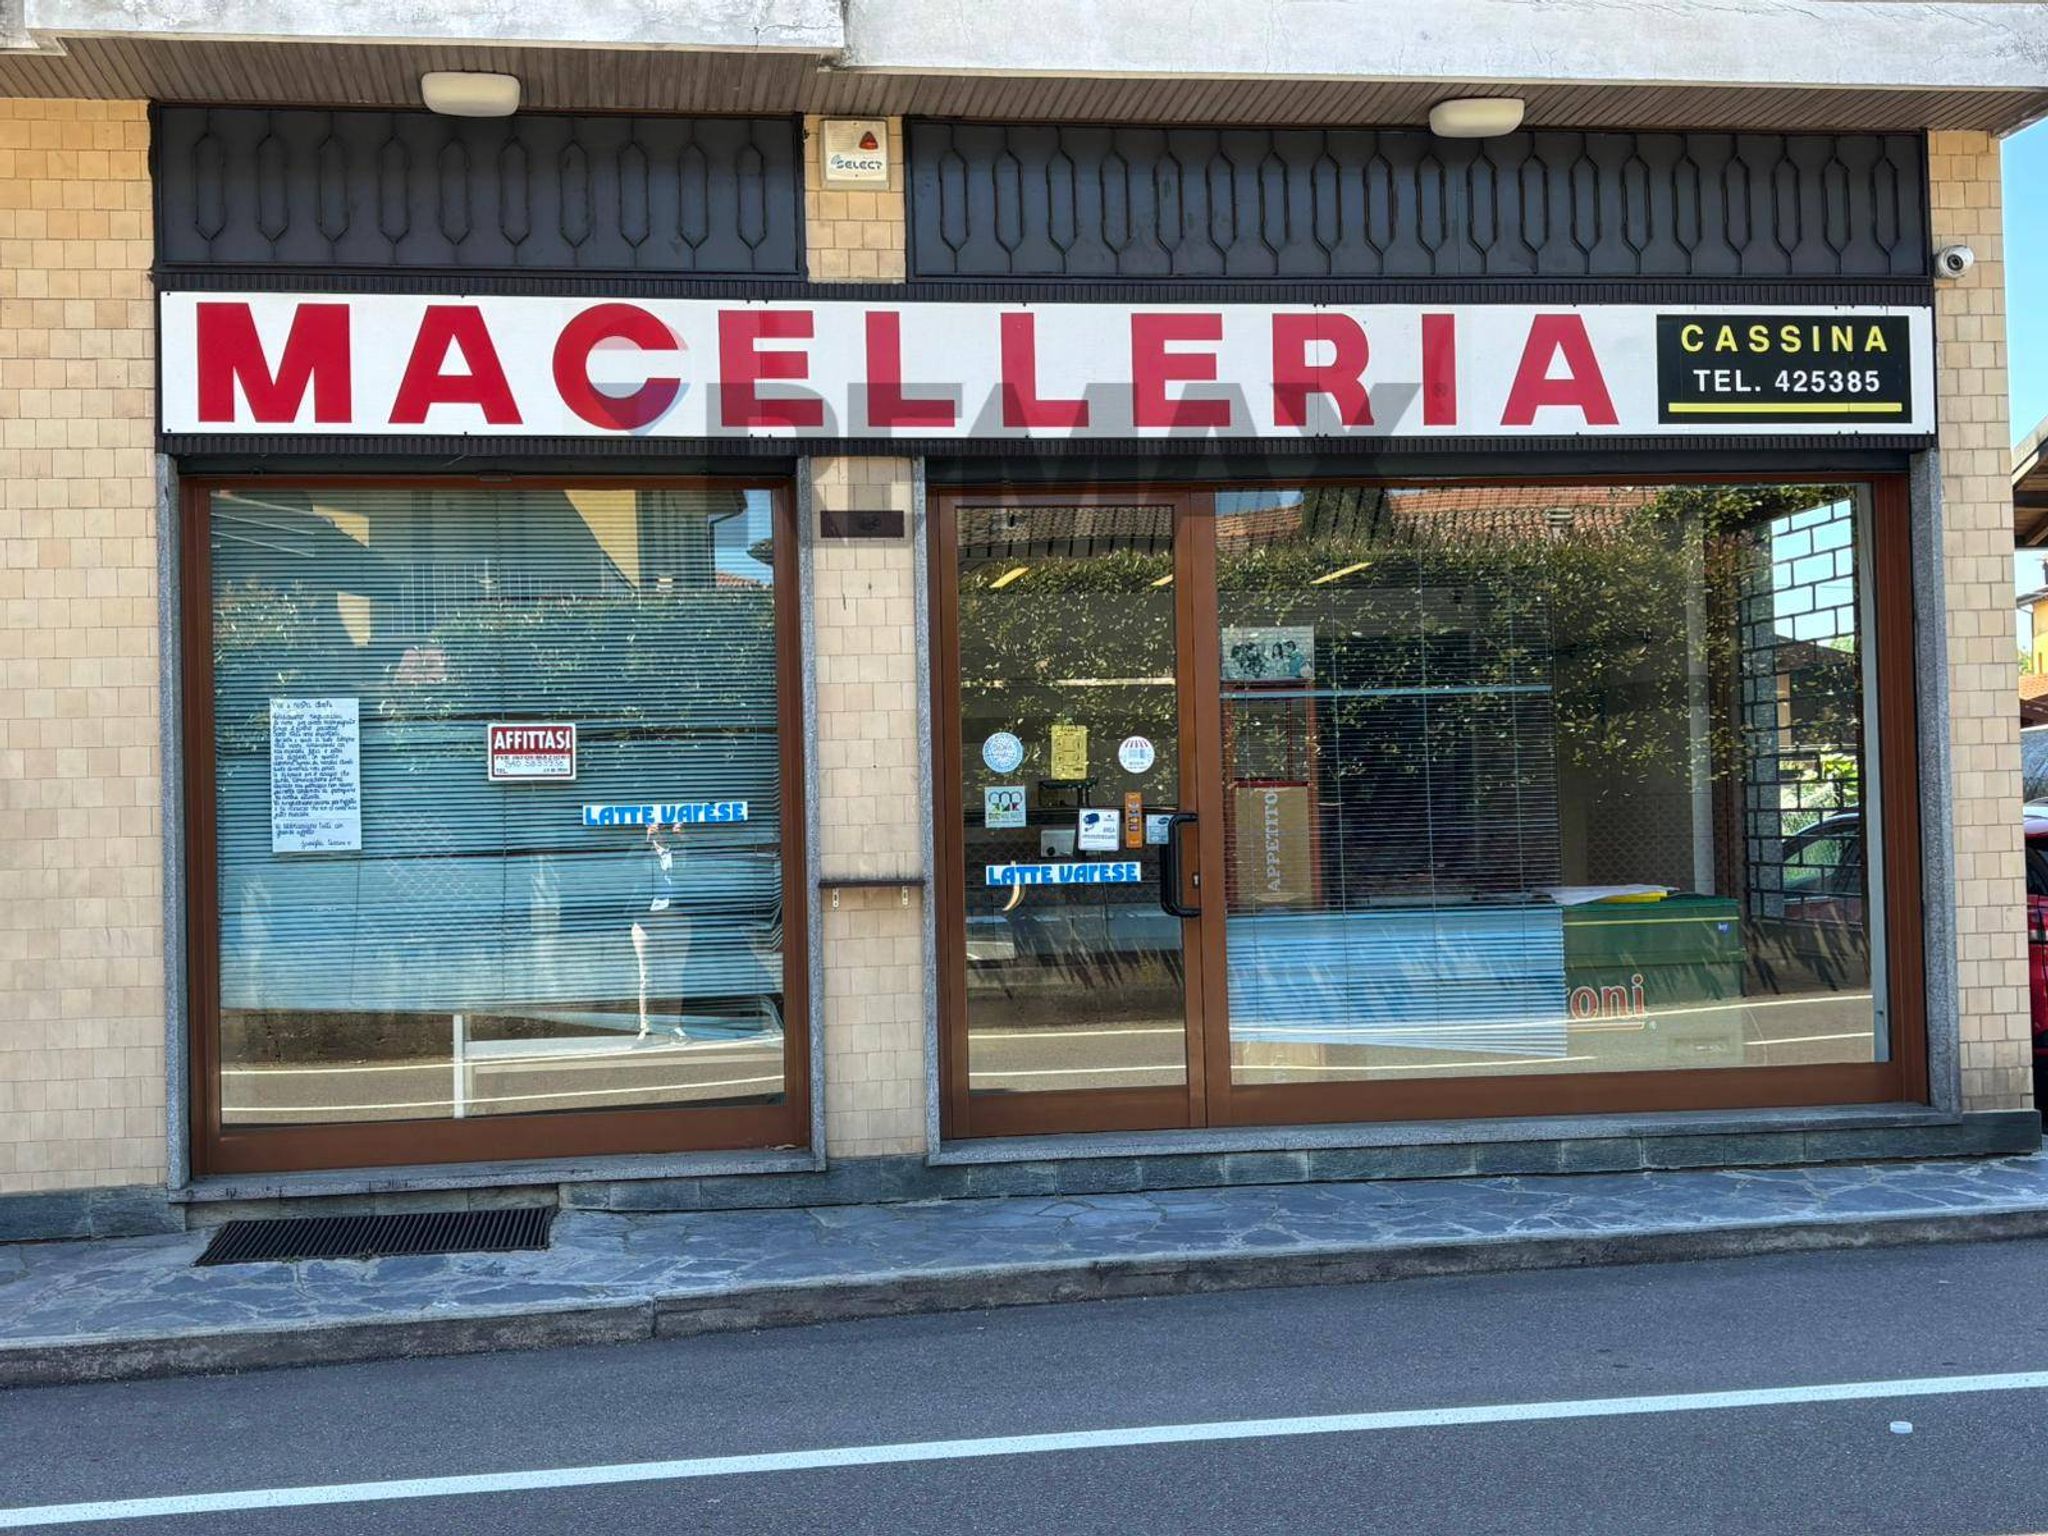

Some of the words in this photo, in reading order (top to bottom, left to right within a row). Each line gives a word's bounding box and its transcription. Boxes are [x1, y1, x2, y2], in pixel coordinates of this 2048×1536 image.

[1681, 324, 1888, 353] CASSINA
[197, 302, 1617, 431] MACELLERIA
[1693, 369, 1761, 392] TEL.
[1775, 370, 1880, 392] 425385
[494, 730, 571, 751] AFFITTASI
[585, 805, 654, 826] LATTE
[988, 865, 1053, 886] LATTE
